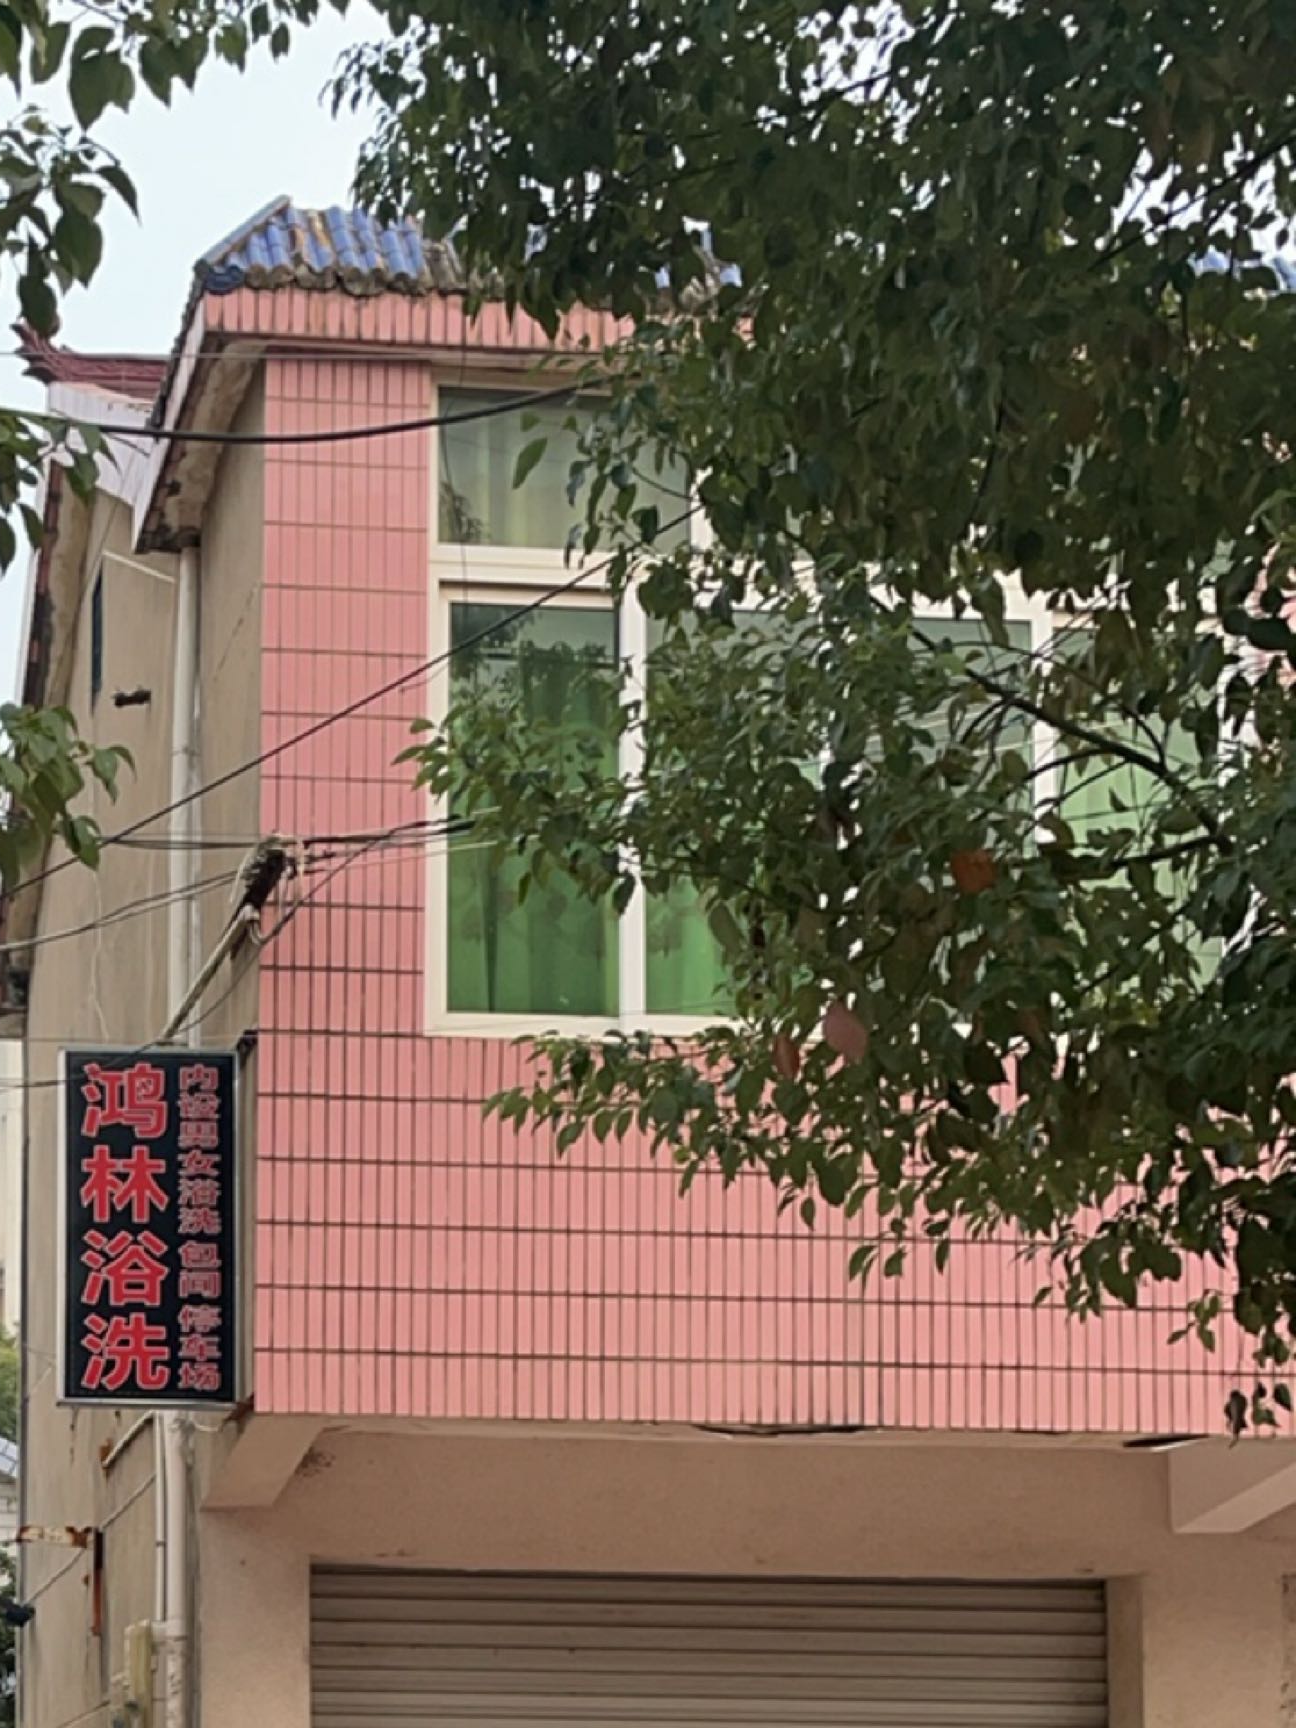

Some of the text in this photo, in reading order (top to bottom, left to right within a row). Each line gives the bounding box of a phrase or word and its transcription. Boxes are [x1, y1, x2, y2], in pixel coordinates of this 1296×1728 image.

[80, 1061, 170, 1391] 鸿林浴洗
[176, 1240, 222, 1299] 包间
[176, 1304, 222, 1391] 停车场
